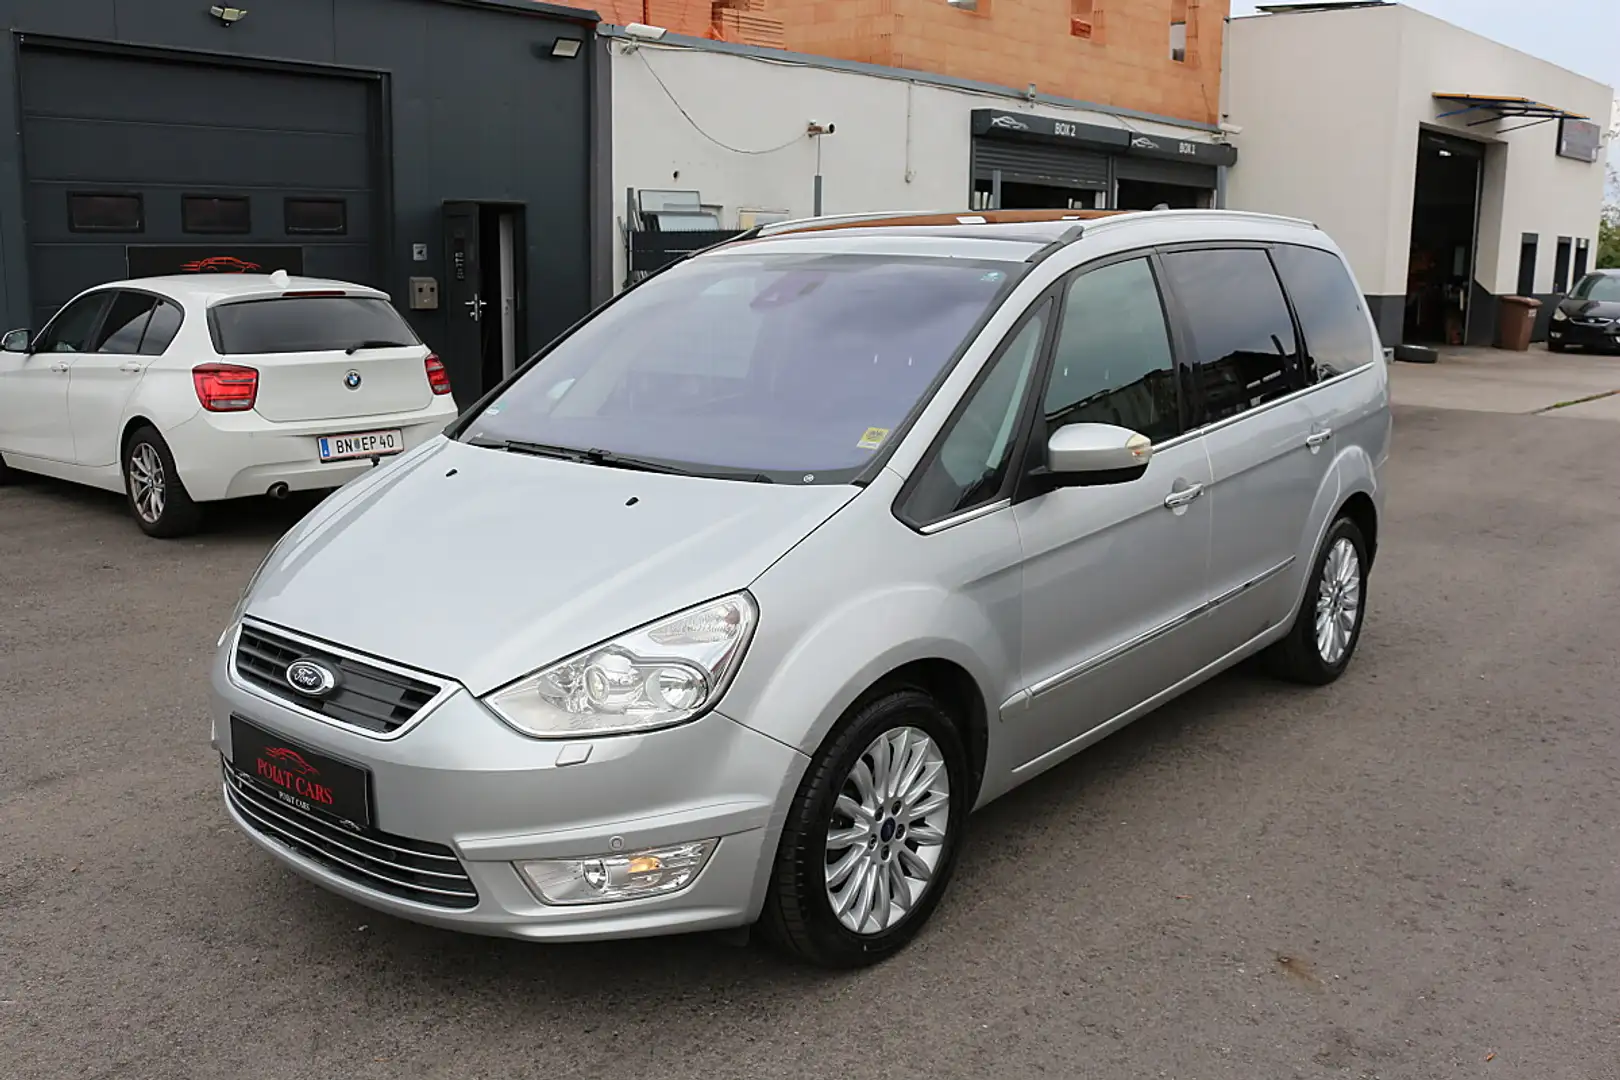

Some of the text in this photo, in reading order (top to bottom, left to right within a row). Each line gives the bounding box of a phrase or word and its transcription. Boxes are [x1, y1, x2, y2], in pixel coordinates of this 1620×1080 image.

[1054, 122, 1076, 137] BOX 2
[336, 434, 394, 454] BN EP 40
[294, 668, 317, 686] Ford
[295, 777, 335, 805] CARS
